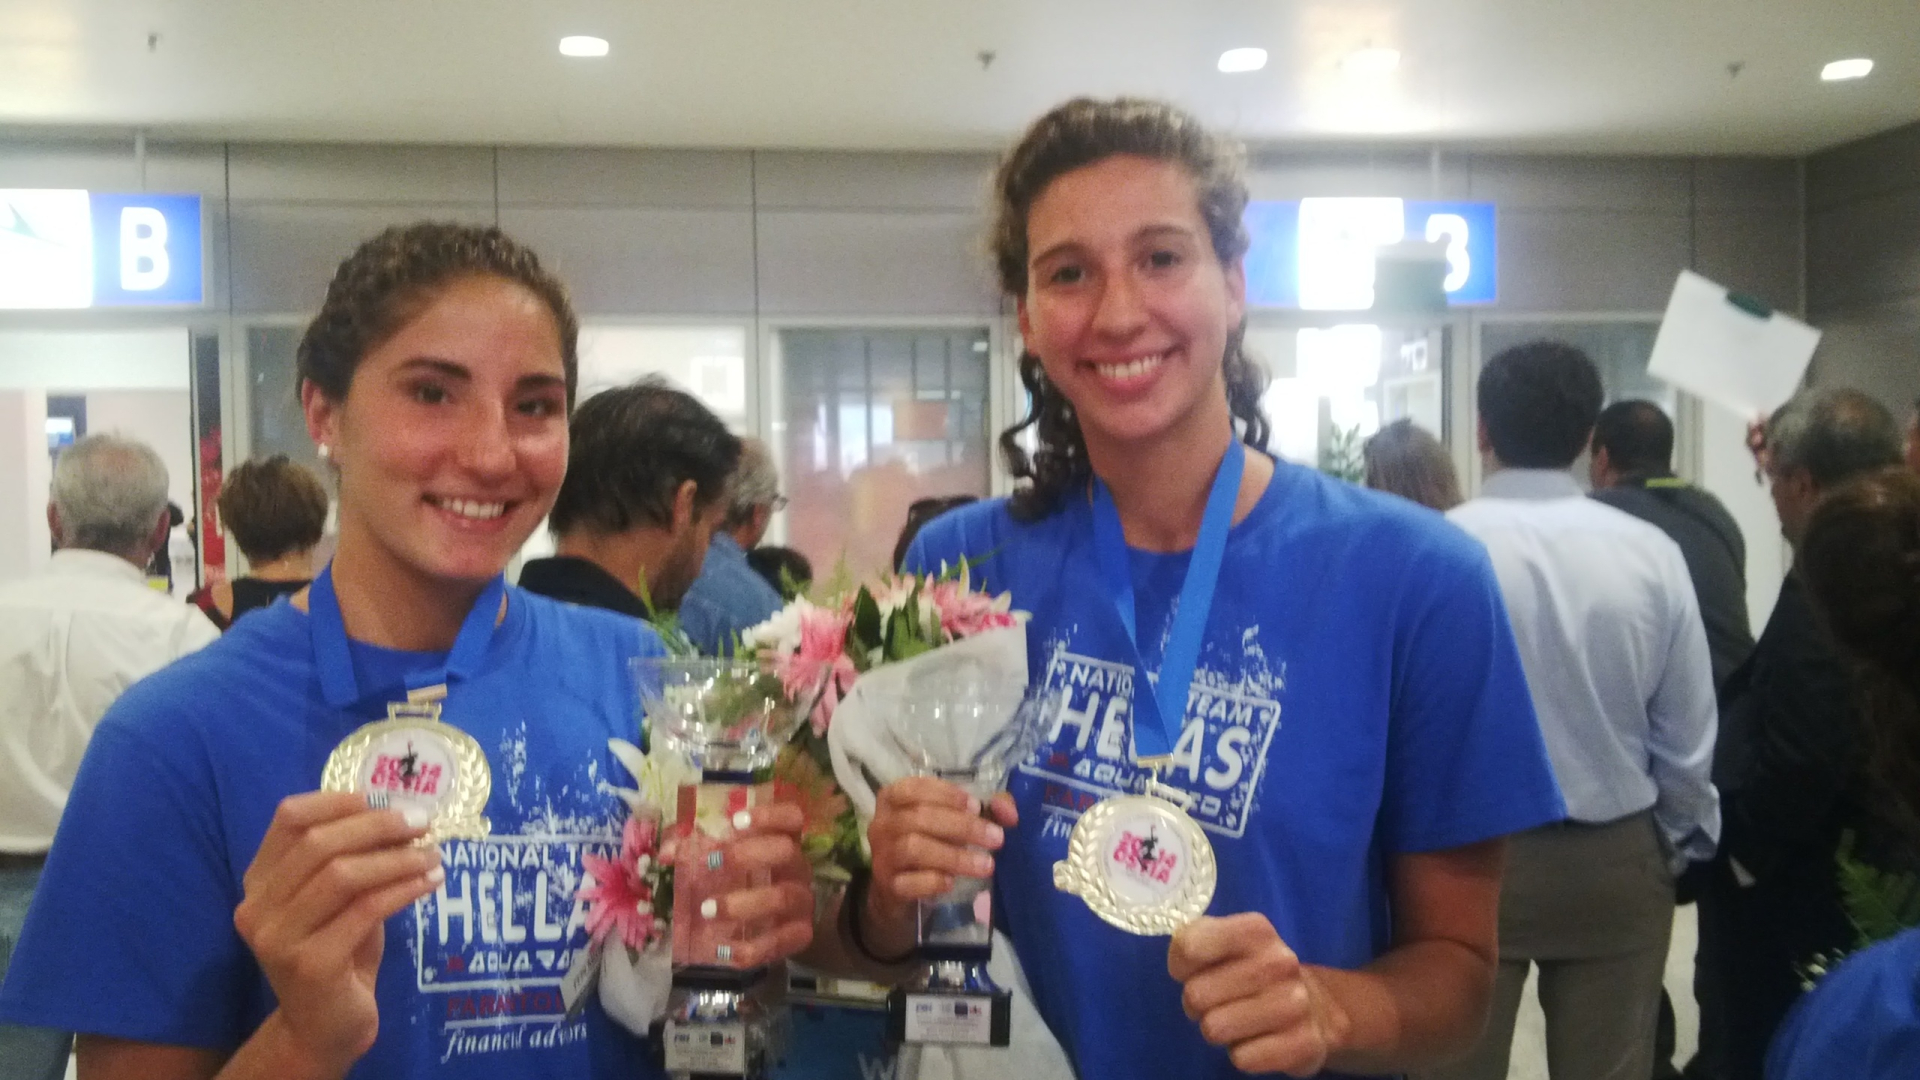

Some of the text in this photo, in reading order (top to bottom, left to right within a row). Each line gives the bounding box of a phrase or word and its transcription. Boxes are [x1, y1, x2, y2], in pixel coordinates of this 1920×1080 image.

[119, 206, 170, 291] B
[1425, 213, 1470, 292] 3
[1069, 664, 1133, 698] NATIO
[1048, 684, 1251, 790] HEAS
[440, 841, 557, 869] NATIONAL
[436, 871, 597, 945] HELLA
